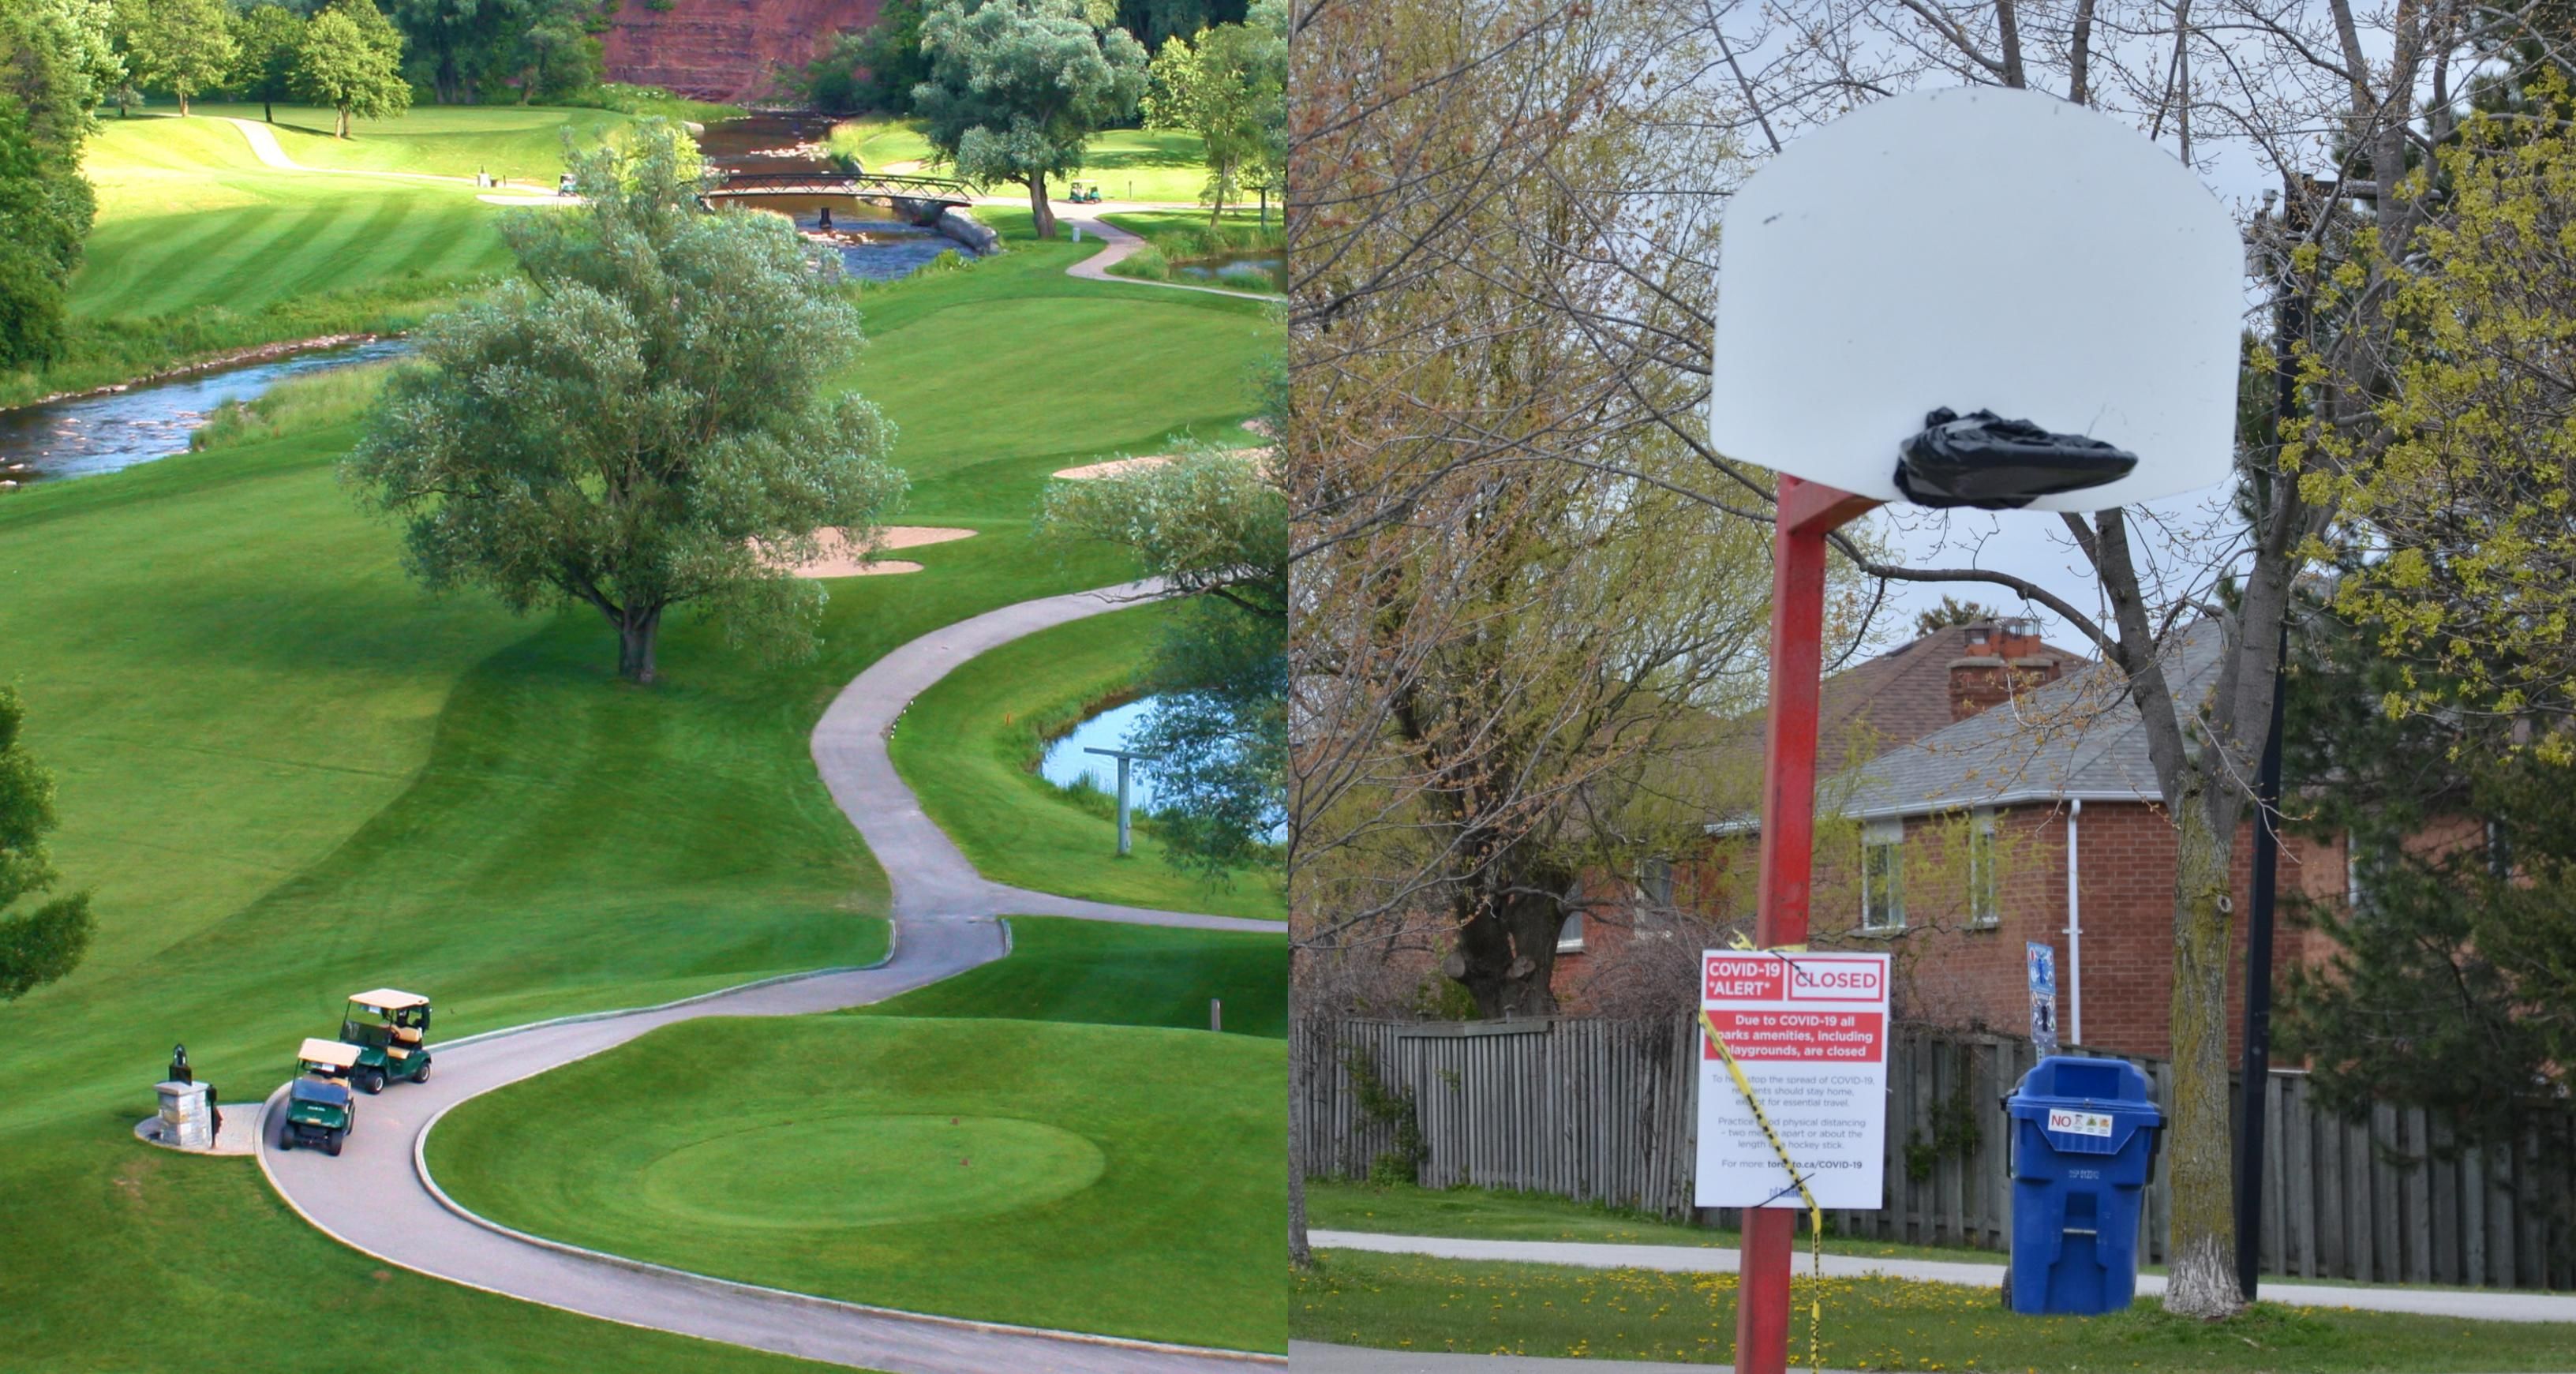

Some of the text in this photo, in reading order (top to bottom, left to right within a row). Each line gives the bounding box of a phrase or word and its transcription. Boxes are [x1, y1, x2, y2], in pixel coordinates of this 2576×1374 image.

[1709, 962, 1780, 977] COVID-19
[1795, 972, 1877, 989] CLOSED
[1735, 1015, 1855, 1028] Due to COVID-19 all
[1753, 1030, 1814, 1043] amenities,
[1818, 1031, 1874, 1043] including
[1726, 1044, 1866, 1058] laygrounds, are closed
[1712, 1074, 1723, 1084] To
[1748, 1075, 1767, 1085] stop
[1769, 1075, 1784, 1084] the
[1786, 1075, 1813, 1086] spread
[1818, 1076, 1829, 1084] of
[1831, 1076, 1876, 1086] COVID-19,
[1732, 1087, 1772, 1095] reents
[1807, 1088, 1825, 1097] stay
[1827, 1088, 1855, 1098] home,
[1735, 1098, 1850, 1107] excpt for essential travel.
[1718, 1117, 1754, 1126] Practice
[1782, 1118, 1818, 1129] physical
[1821, 1118, 1866, 1129] distancing
[2051, 1114, 2072, 1128] NO
[1728, 1129, 1747, 1137] two
[1781, 1129, 1805, 1140] apart
[1819, 1129, 1846, 1139] about
[1848, 1129, 1863, 1139] the
[1737, 1140, 1766, 1150] length
[1788, 1140, 1820, 1151] hockey
[1822, 1140, 1844, 1150] stick.
[1721, 1159, 1738, 1168] For
[1768, 1159, 1863, 1170] toroto.ca/COVID-19
